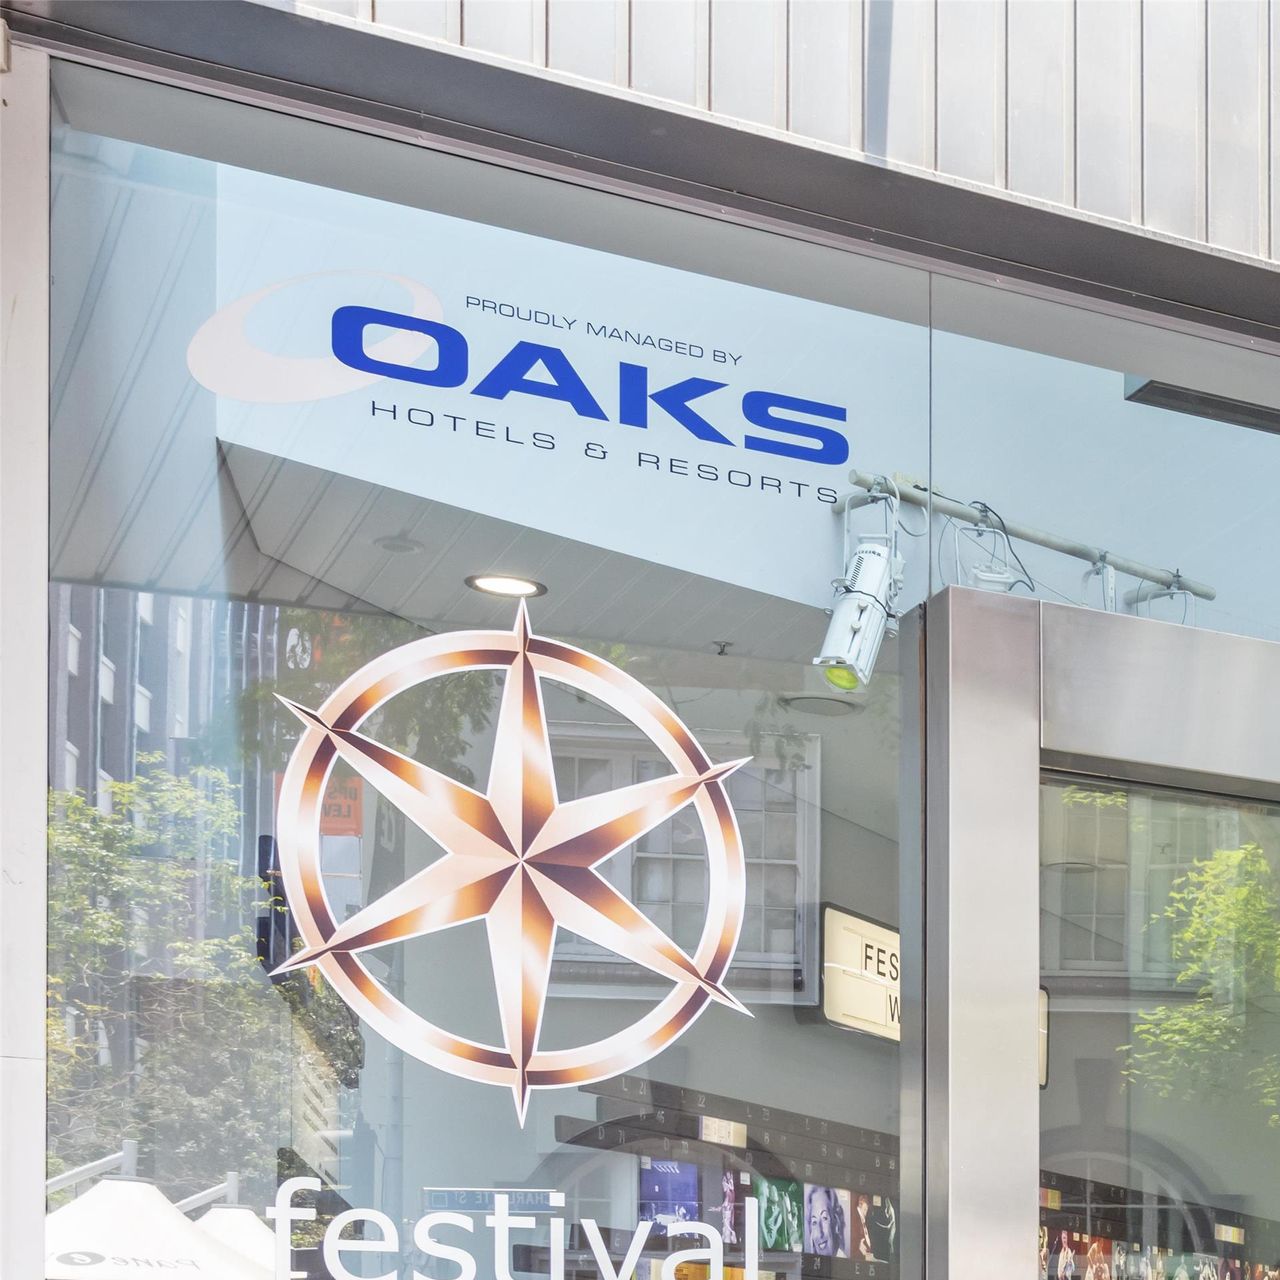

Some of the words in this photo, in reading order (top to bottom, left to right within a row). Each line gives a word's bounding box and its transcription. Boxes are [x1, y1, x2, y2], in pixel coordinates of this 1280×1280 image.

[466, 295, 578, 331] PROUDLY
[586, 322, 705, 358] MANAGED
[712, 352, 743, 368] BY
[331, 305, 849, 466] OAKS
[372, 400, 557, 451] HOTELS
[584, 442, 609, 460] &
[638, 451, 839, 505] RESORTS
[864, 943, 899, 981] FES
